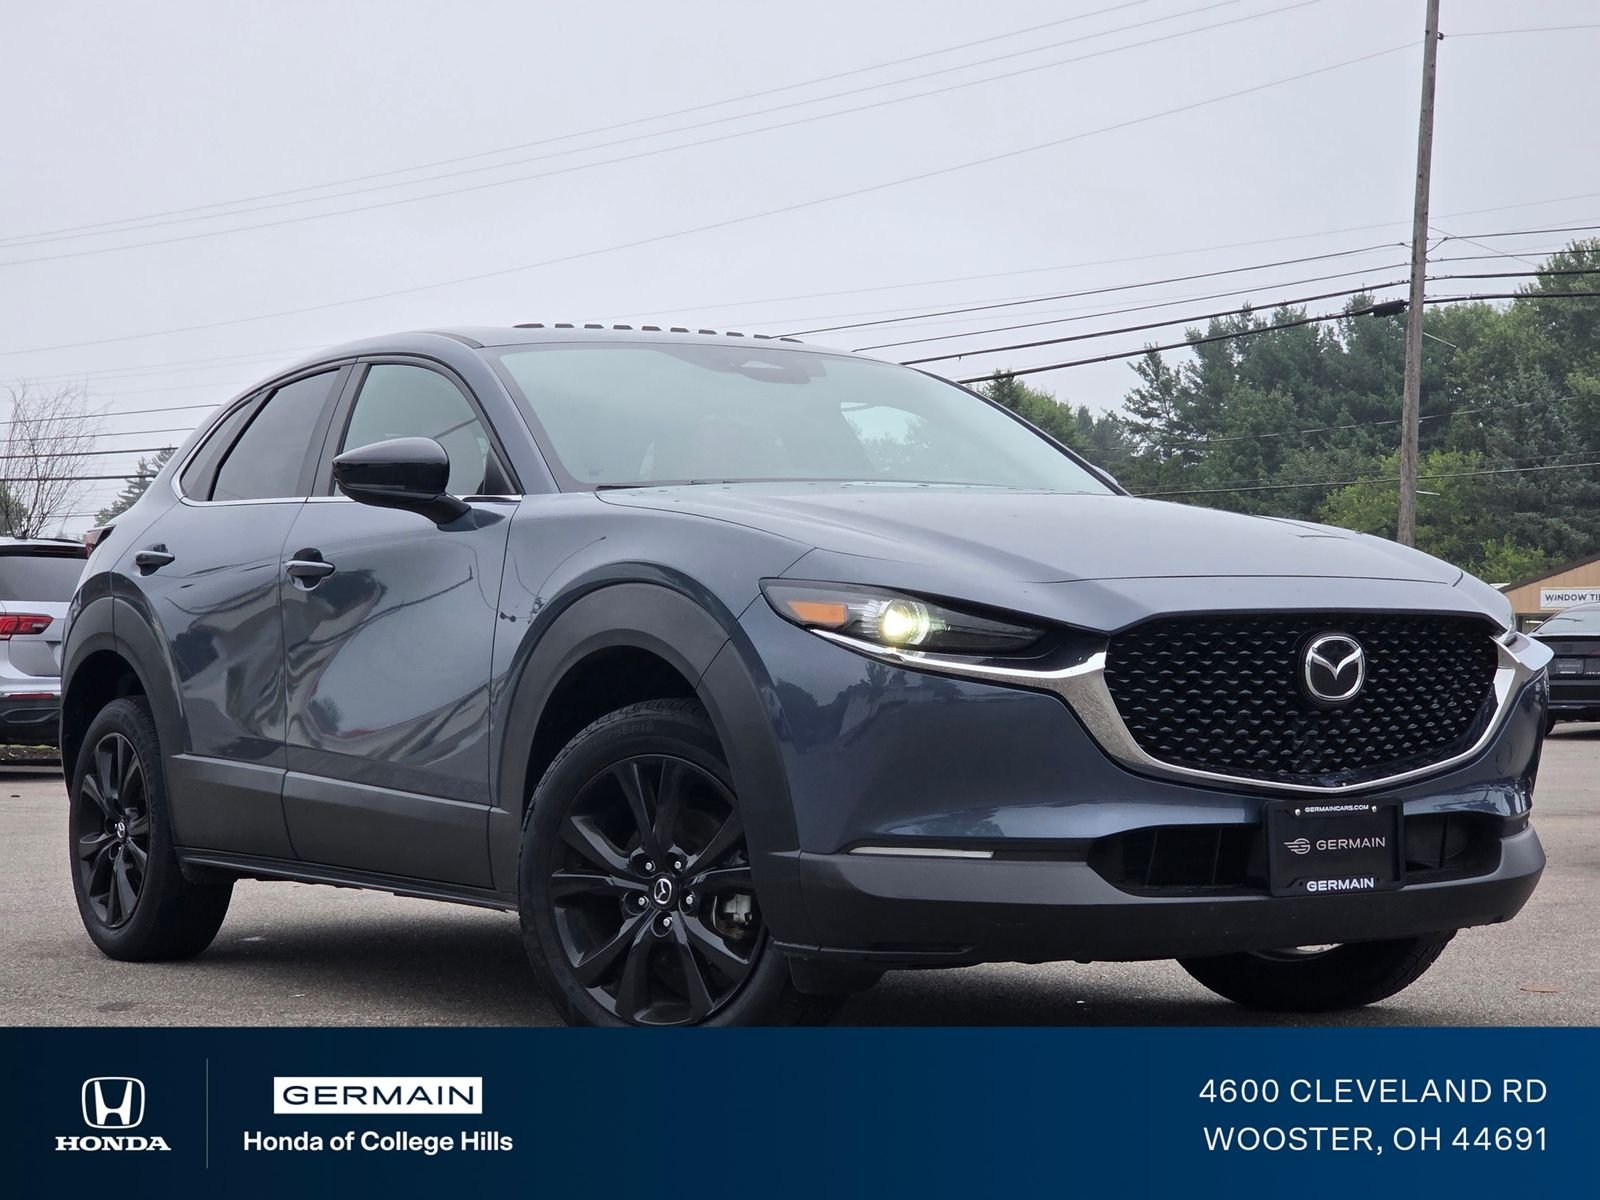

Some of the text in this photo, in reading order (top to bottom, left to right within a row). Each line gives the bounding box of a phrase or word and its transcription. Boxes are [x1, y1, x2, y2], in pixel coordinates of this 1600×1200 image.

[1545, 593, 1588, 602] WINDOW
[1304, 804, 1370, 813] GERMAINCARS.COM
[1315, 836, 1387, 851] GERMAIN
[1306, 877, 1375, 892] GERMAIN
